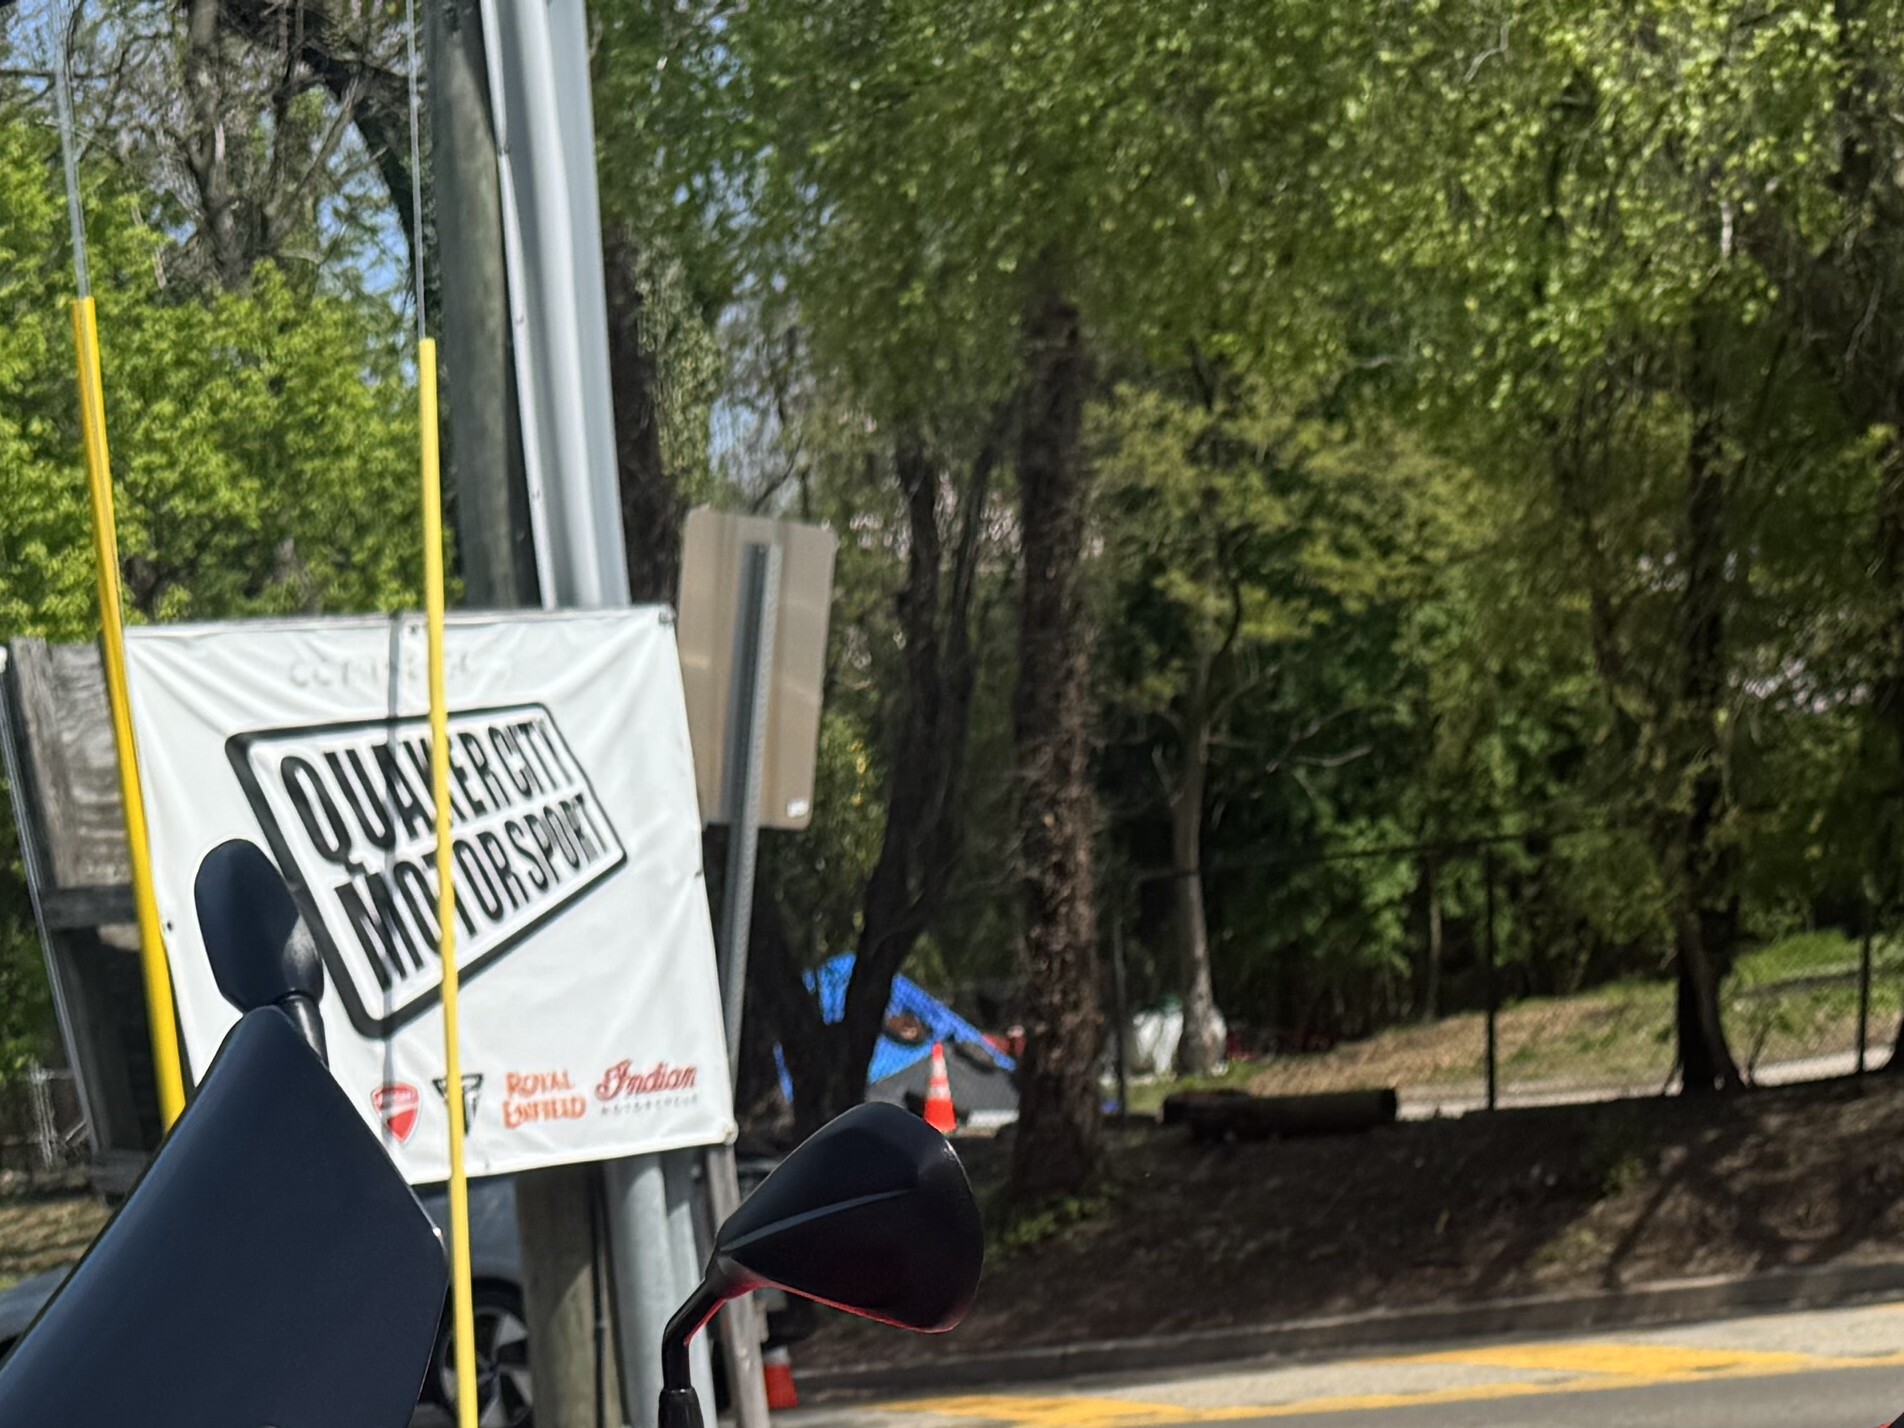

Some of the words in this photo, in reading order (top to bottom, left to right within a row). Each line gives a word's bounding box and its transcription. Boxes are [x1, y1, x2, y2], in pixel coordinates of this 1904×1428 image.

[505, 1069, 575, 1098] ROYAL
[595, 1058, 697, 1101] Indian
[502, 1096, 588, 1129] ENFIELD
